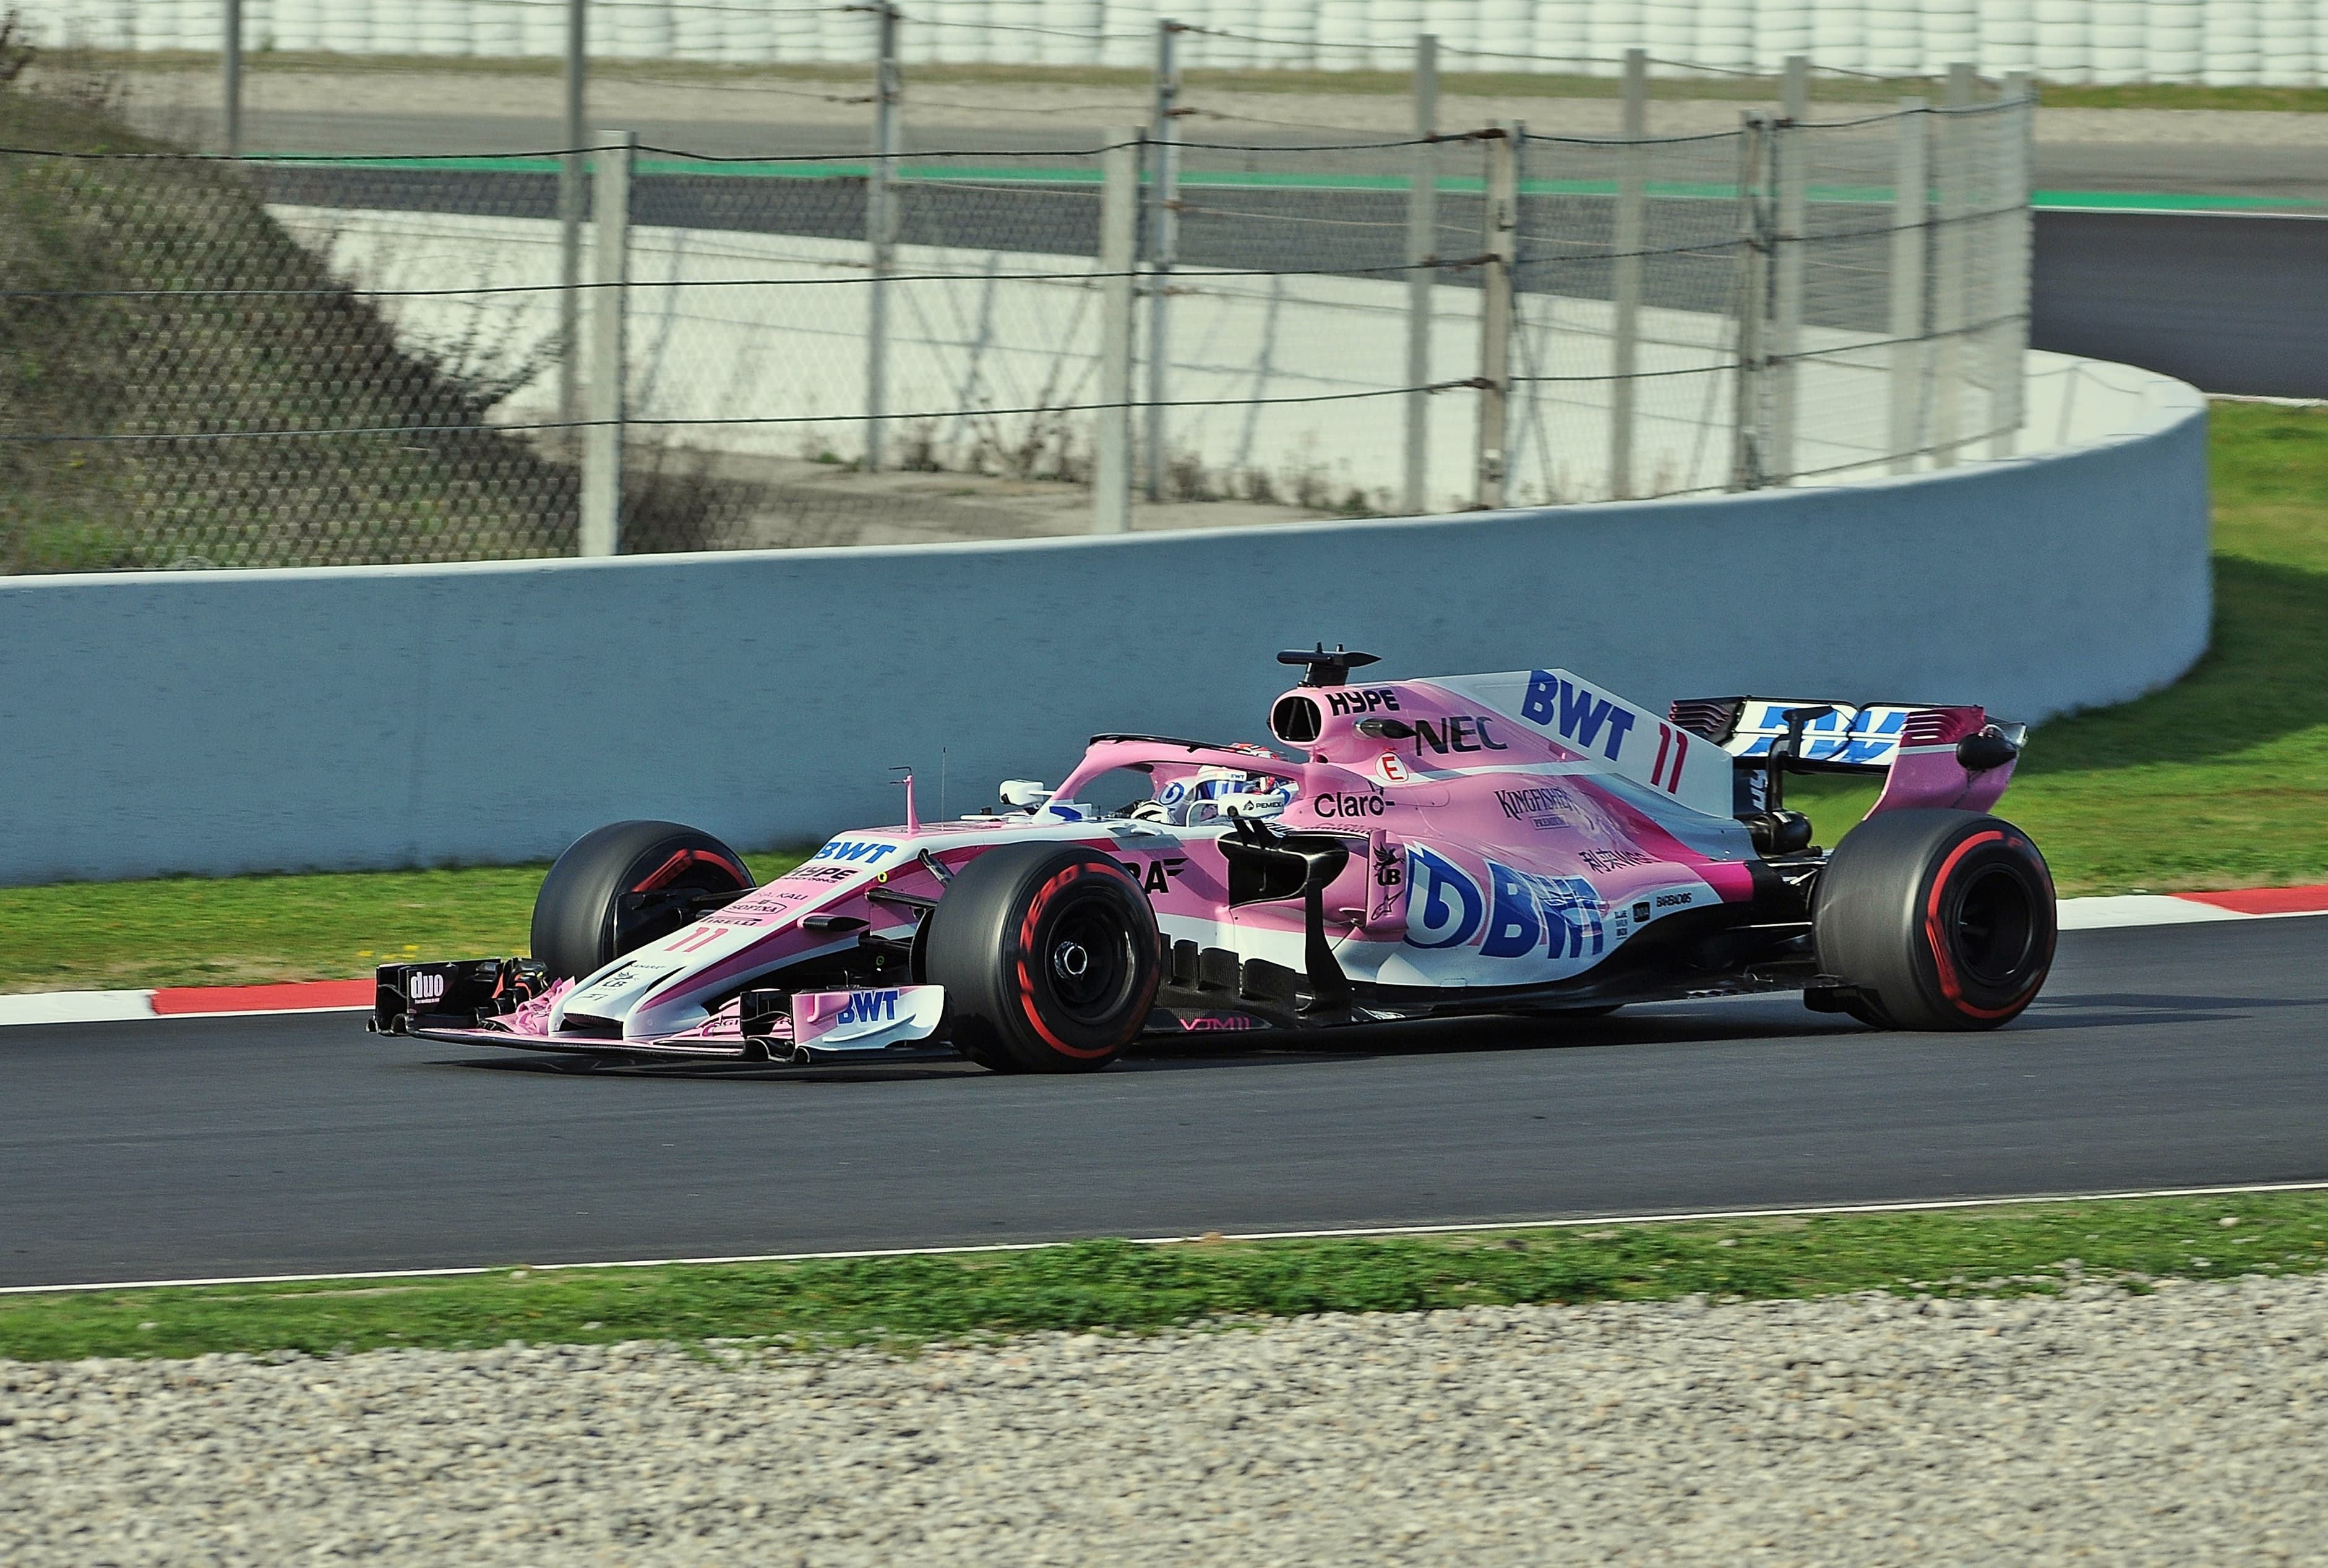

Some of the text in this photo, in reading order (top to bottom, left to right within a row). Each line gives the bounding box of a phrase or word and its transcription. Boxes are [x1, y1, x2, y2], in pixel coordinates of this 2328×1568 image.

[1325, 690, 1400, 716] HYPE
[1521, 669, 1635, 761] BWT
[1415, 716, 1508, 750] NEC
[1651, 722, 1688, 794] 11
[1315, 792, 1385, 818] Claro
[813, 842, 897, 863] BWT
[788, 867, 859, 880] HYPE
[663, 927, 729, 952] 11
[410, 971, 444, 998] duo
[837, 990, 898, 1025] BWT
